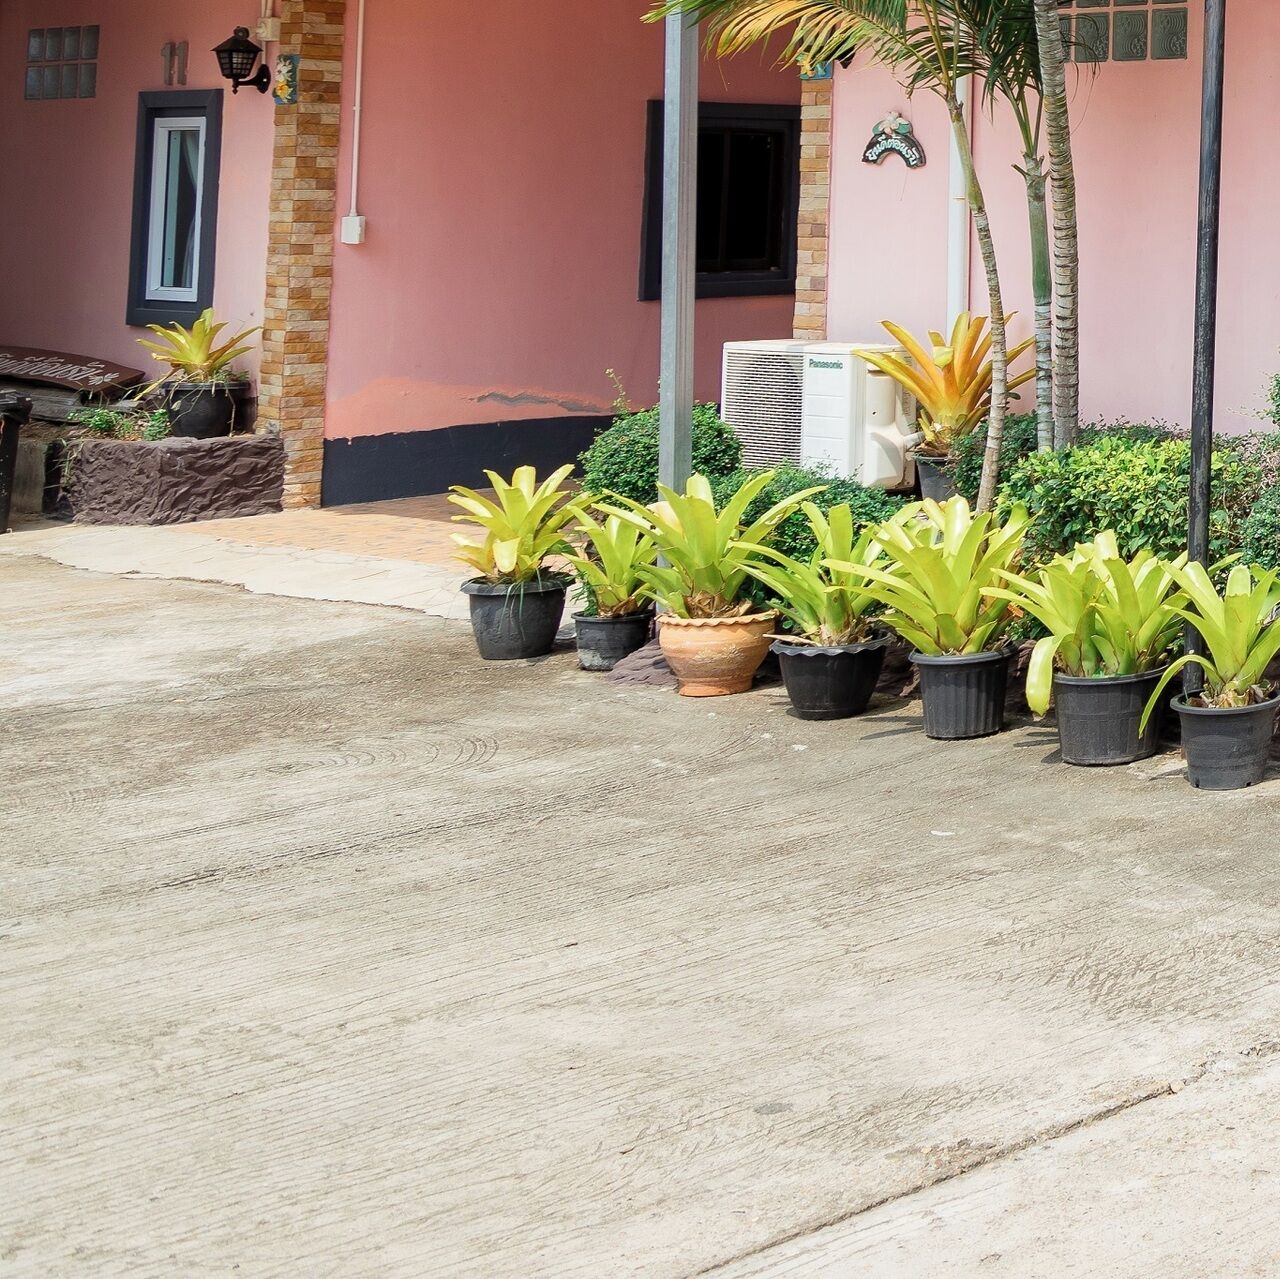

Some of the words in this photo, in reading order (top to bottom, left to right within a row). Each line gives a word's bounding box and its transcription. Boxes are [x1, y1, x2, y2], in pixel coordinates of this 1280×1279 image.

[161, 40, 189, 85] 11
[865, 134, 920, 165] ยินดีต้อนรับ
[808, 358, 843, 369] Panasonic
